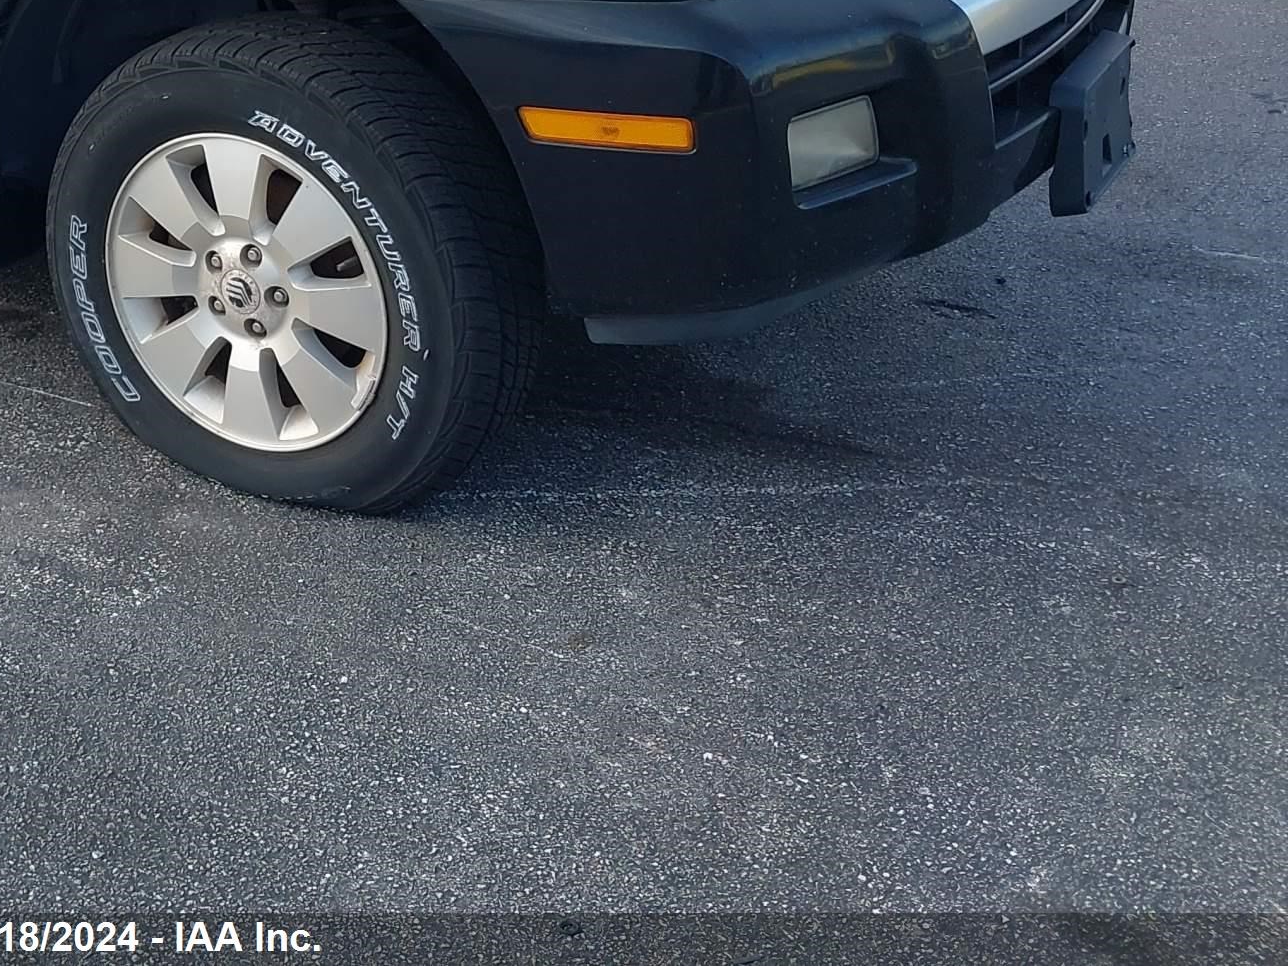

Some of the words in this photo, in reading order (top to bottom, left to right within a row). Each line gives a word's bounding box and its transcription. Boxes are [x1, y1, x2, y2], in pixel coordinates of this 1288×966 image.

[67, 213, 142, 404] COOPER
[247, 108, 425, 356] ADVENTURER
[384, 363, 421, 442] H/T
